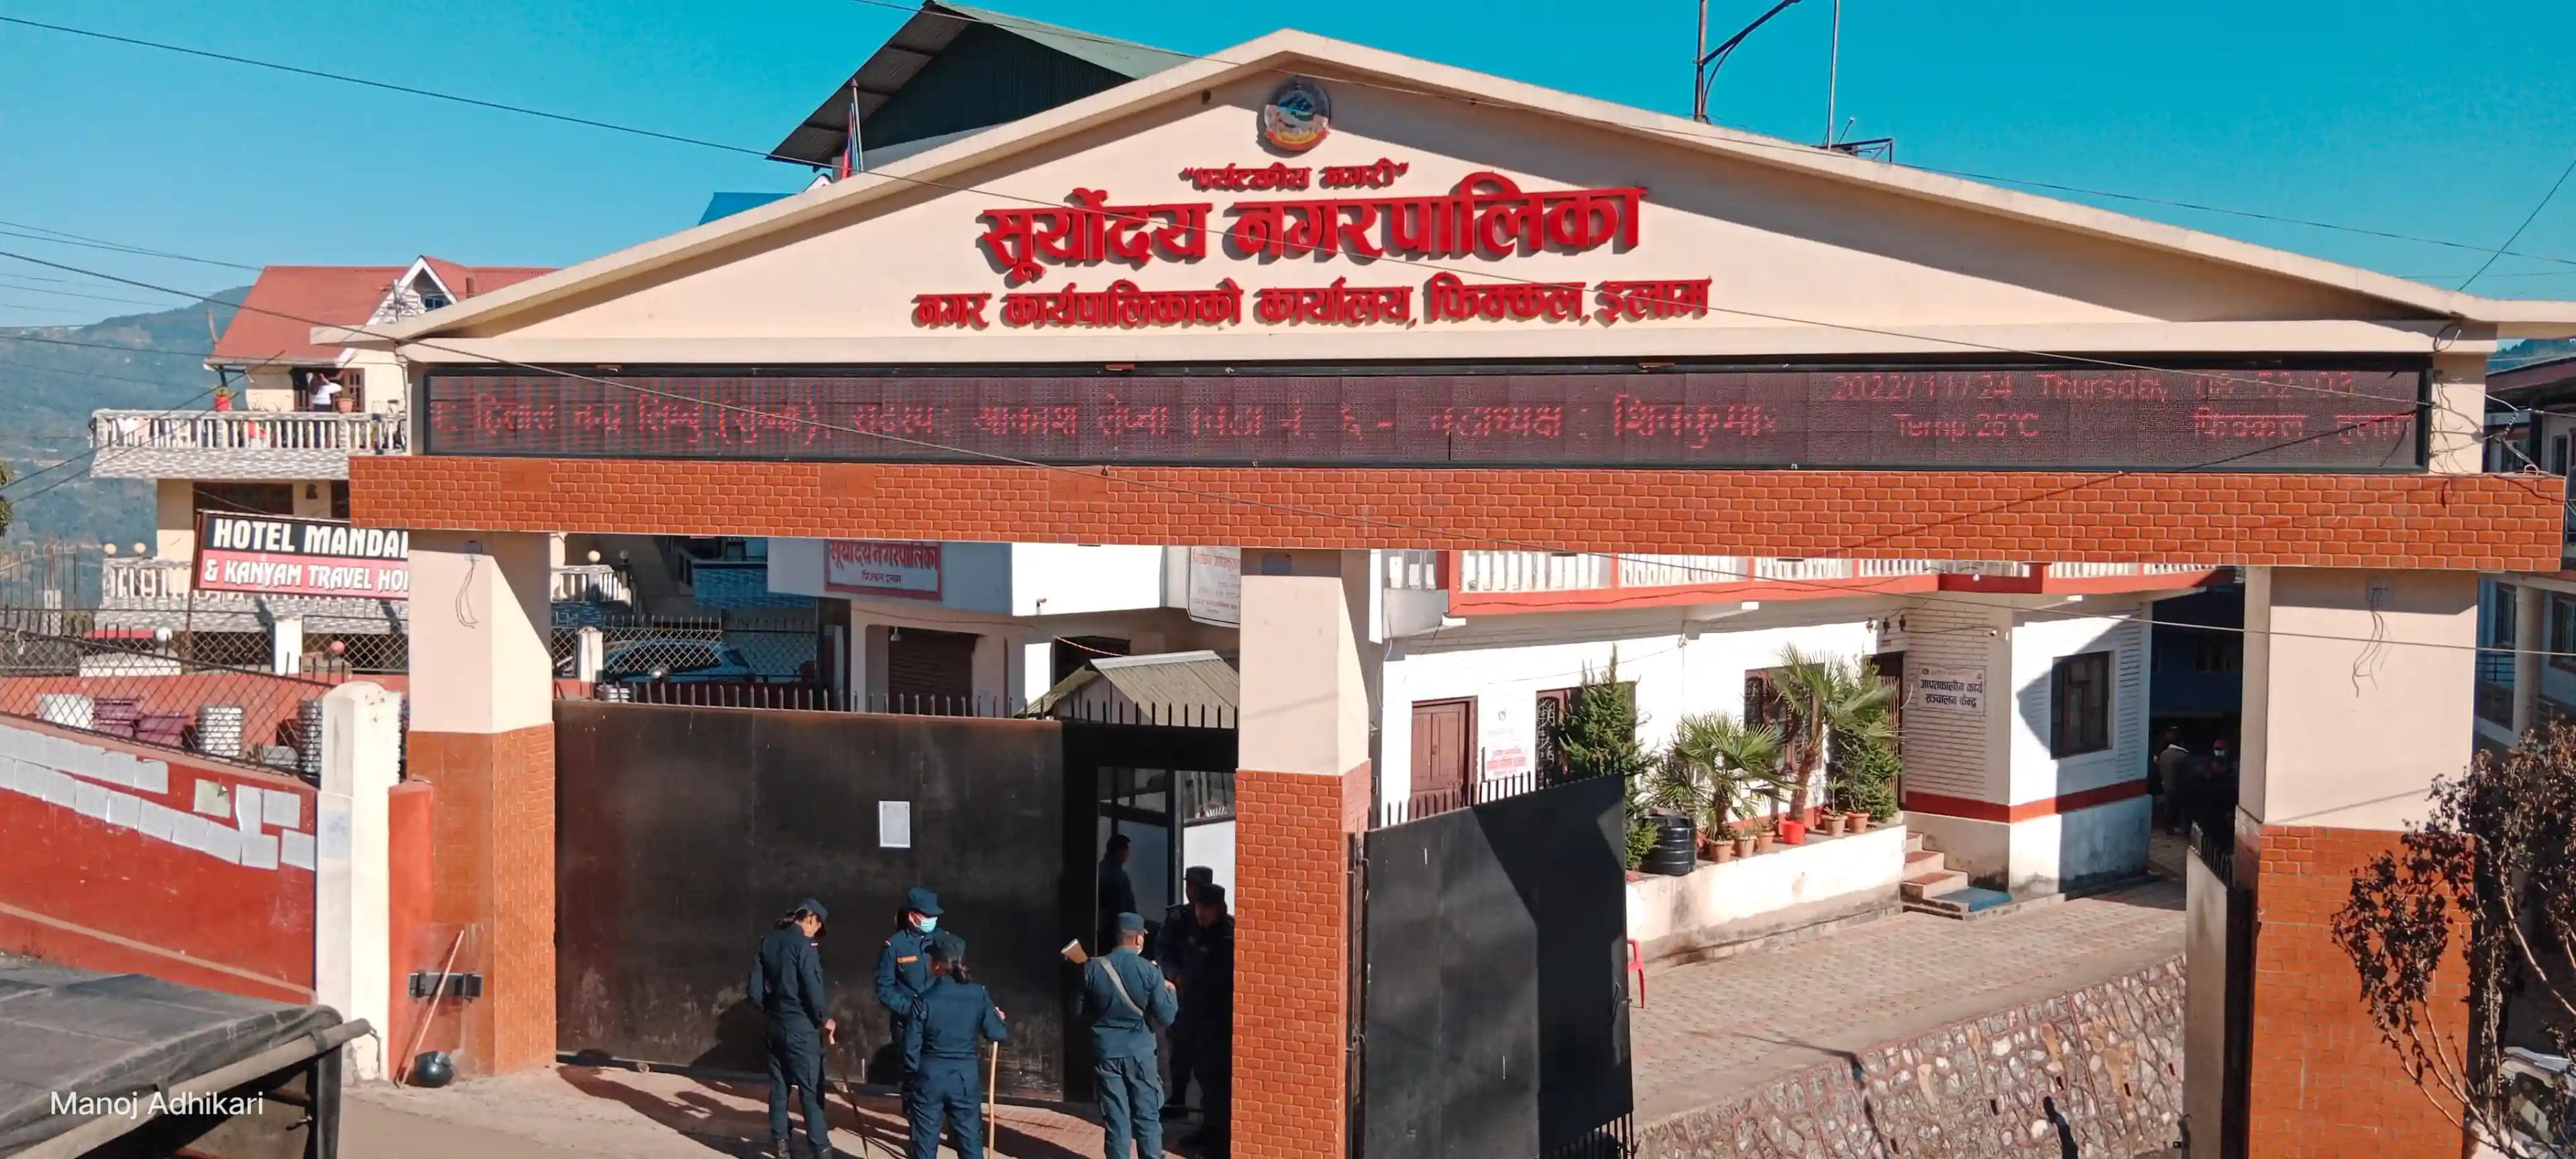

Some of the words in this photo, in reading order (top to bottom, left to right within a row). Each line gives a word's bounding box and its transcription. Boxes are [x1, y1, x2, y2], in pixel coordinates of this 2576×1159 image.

[983, 187, 1213, 284] सूर्योदय
[1232, 172, 1648, 257] नगरपालिका
[914, 292, 993, 327] नगर
[1004, 278, 1244, 327] कार्यपालिकाको
[1258, 276, 1418, 329] कार्यालय,
[1599, 276, 1713, 326] इलाम
[213, 518, 296, 552] HOTEL
[204, 558, 219, 583] &
[224, 559, 303, 588] KANYAM
[308, 564, 372, 591] TRAVEL
